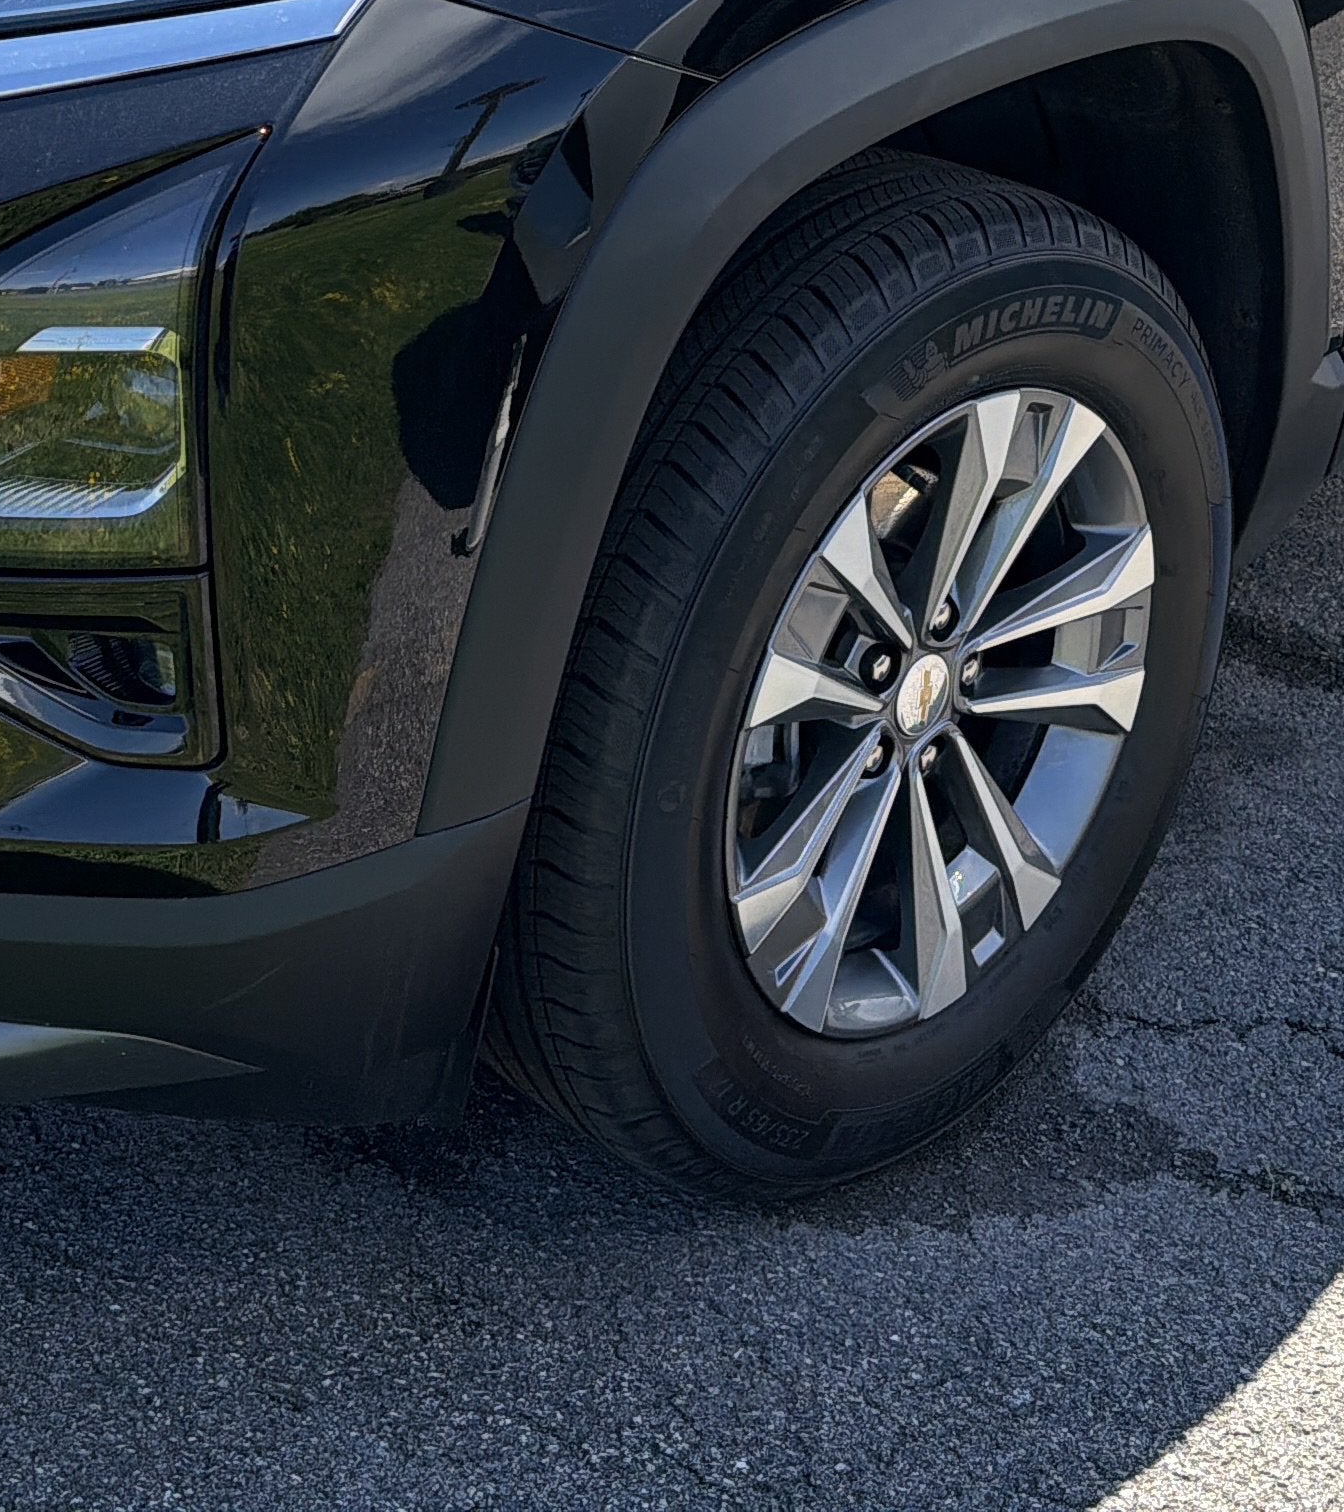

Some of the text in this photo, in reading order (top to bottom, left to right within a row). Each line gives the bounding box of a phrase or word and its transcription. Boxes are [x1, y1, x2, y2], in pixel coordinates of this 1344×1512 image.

[954, 295, 1114, 357] MICHELIN
[1131, 317, 1192, 389] PRIMACY
[740, 1108, 811, 1150] 235/65
